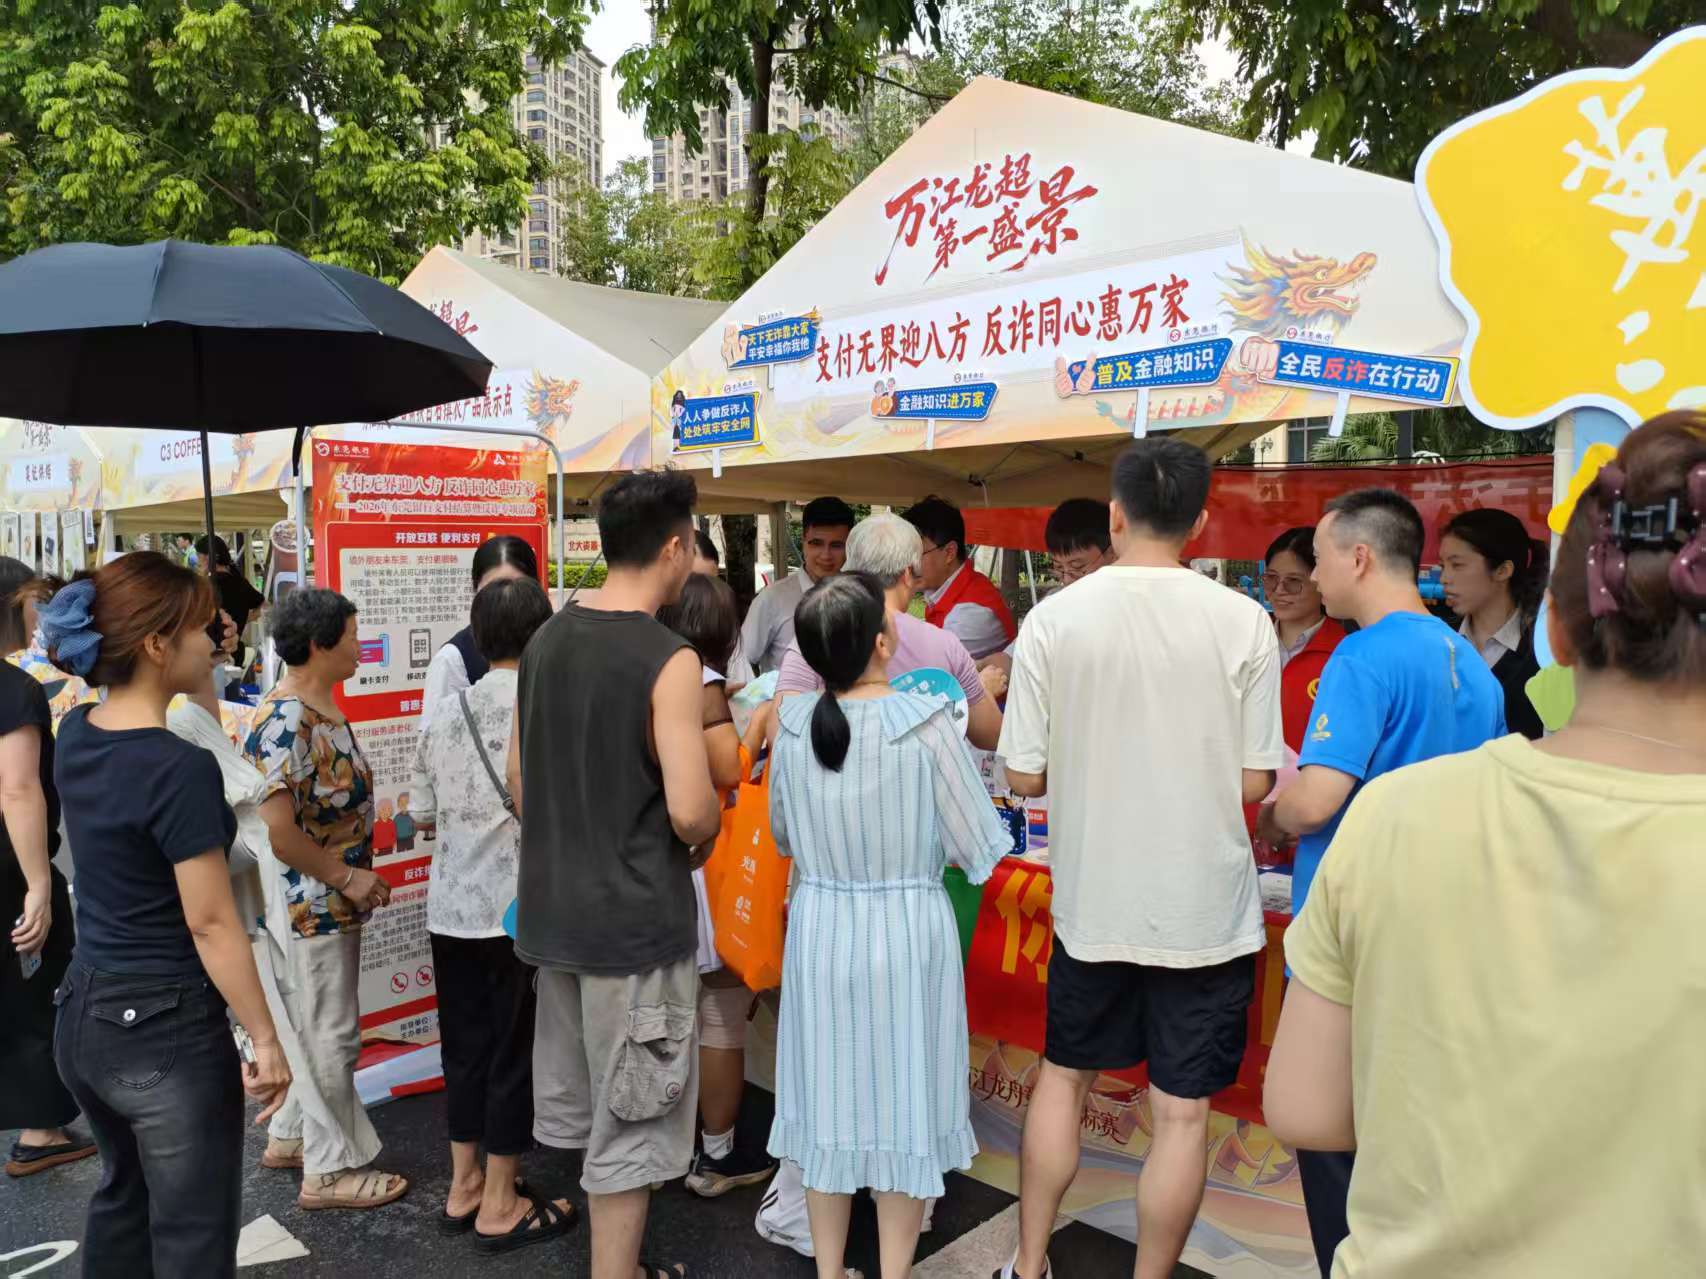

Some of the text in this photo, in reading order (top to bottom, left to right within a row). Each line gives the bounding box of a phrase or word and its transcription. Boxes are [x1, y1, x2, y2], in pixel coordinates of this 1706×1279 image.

[875, 153, 1034, 286] 万江龙超
[924, 166, 1098, 285] 第一盛景
[749, 321, 809, 346] 天下无诈靠大家
[816, 274, 1190, 383] 支付无界迎八方 反诈同心惠万家
[749, 338, 809, 361] 平安幸福你我他
[1096, 348, 1215, 386] 普及金融知识
[1279, 352, 1440, 393] 全民反诈在行动
[684, 401, 750, 424] 人人争做反诈人
[899, 391, 985, 412] 金融知识进万家
[174, 437, 202, 458] COFFE
[336, 472, 537, 498] 支付无界迎八方 反诈同心惠万家
[396, 532, 481, 544] 开放互联 便利支付
[406, 672, 427, 681] 移动支
